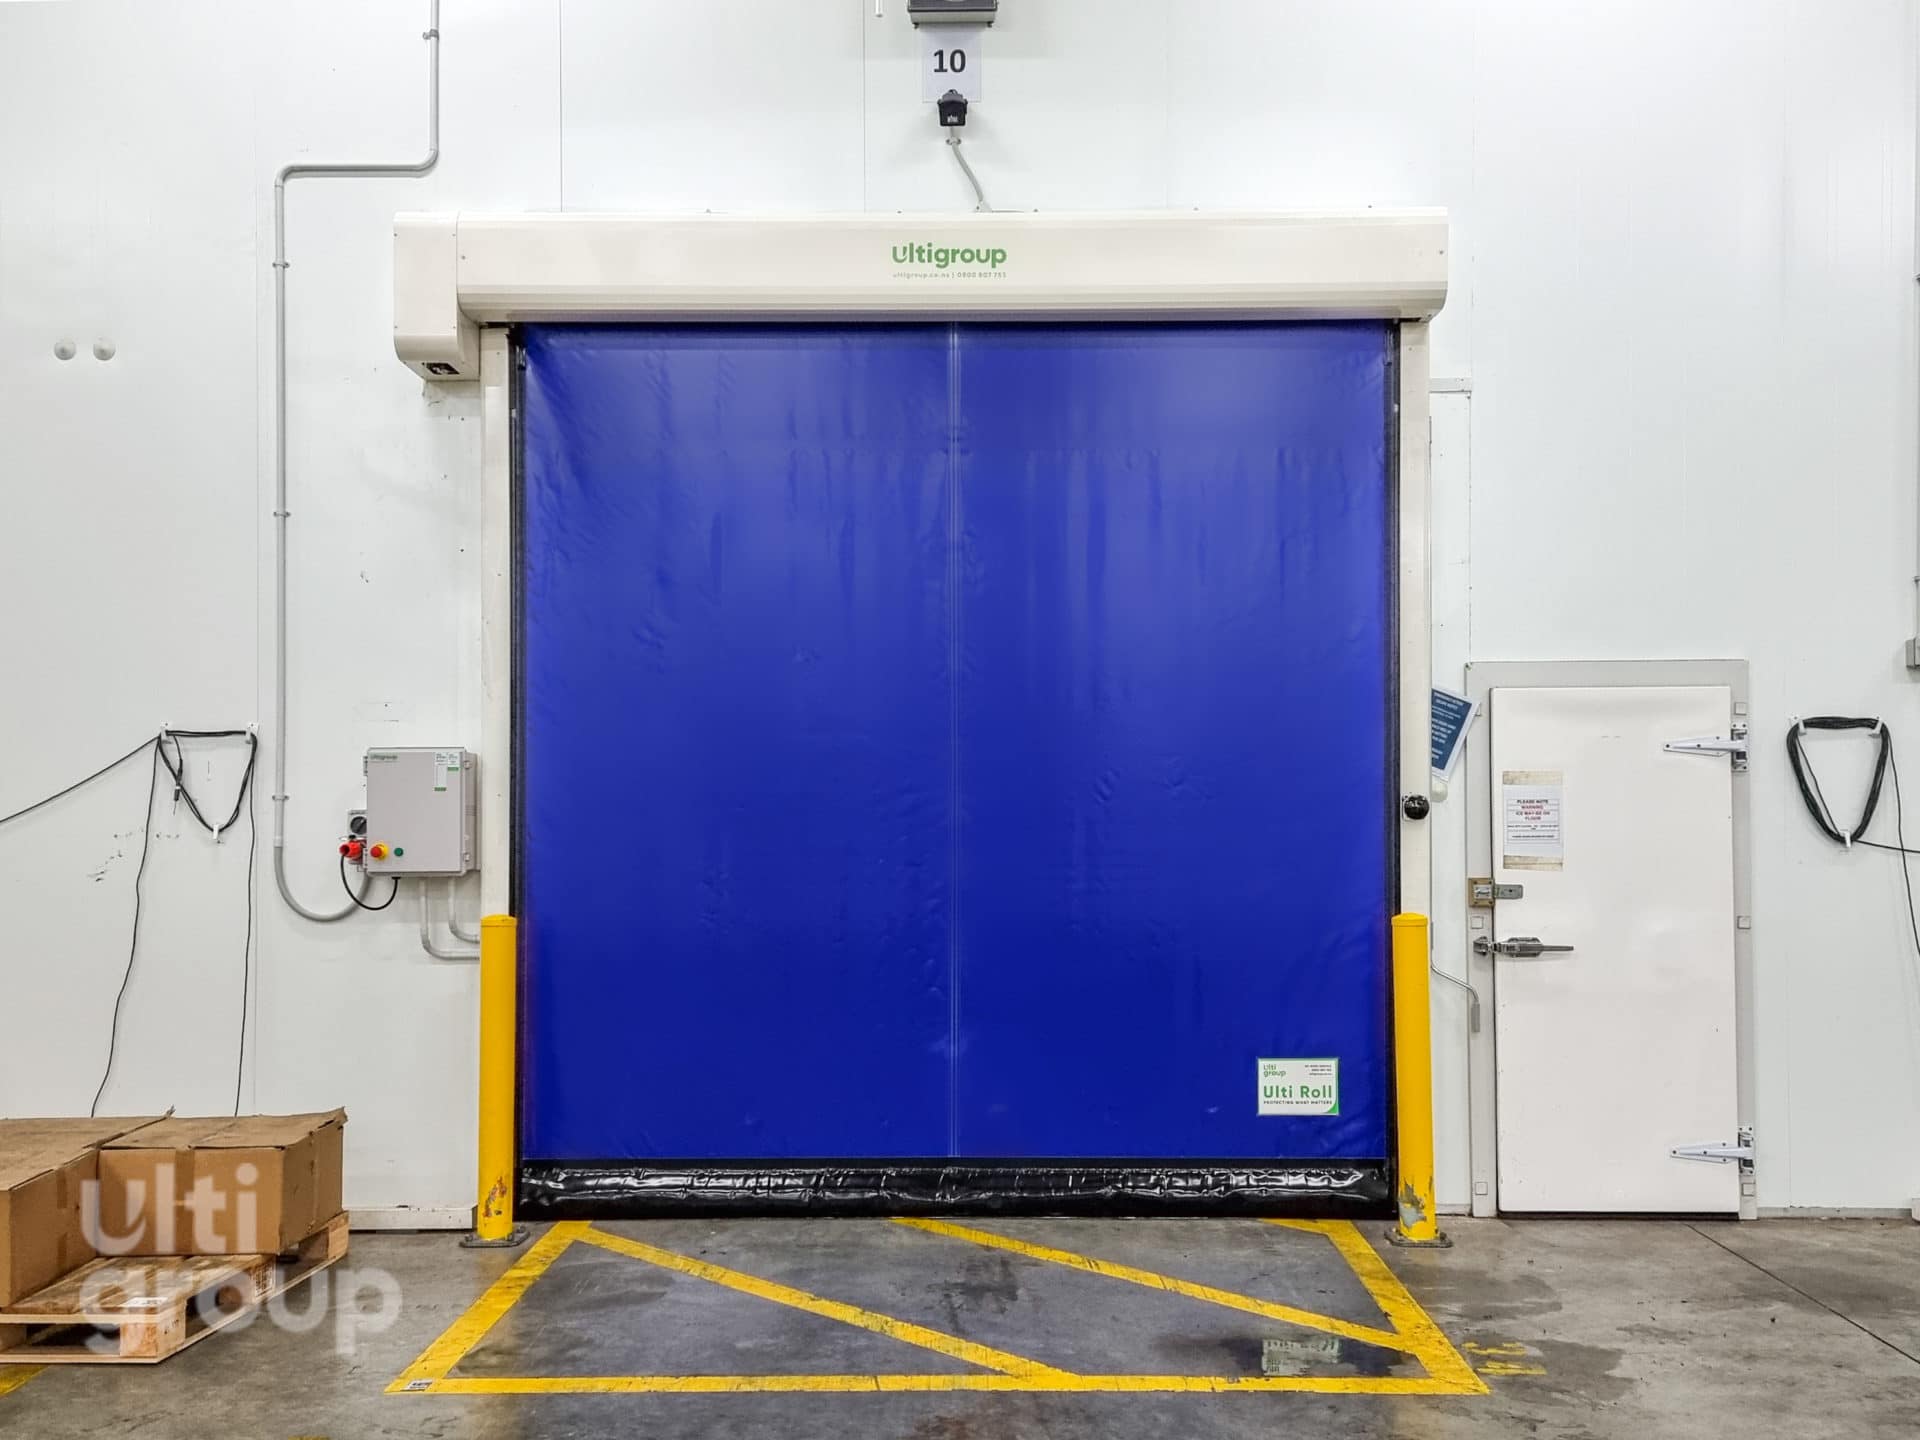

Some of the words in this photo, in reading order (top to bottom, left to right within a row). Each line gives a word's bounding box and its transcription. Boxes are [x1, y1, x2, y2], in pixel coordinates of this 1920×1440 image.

[933, 48, 966, 73] 10
[892, 242, 1007, 269] ultigroup
[1263, 1085, 1293, 1098] Ulti
[1300, 1085, 1332, 1098] Roll
